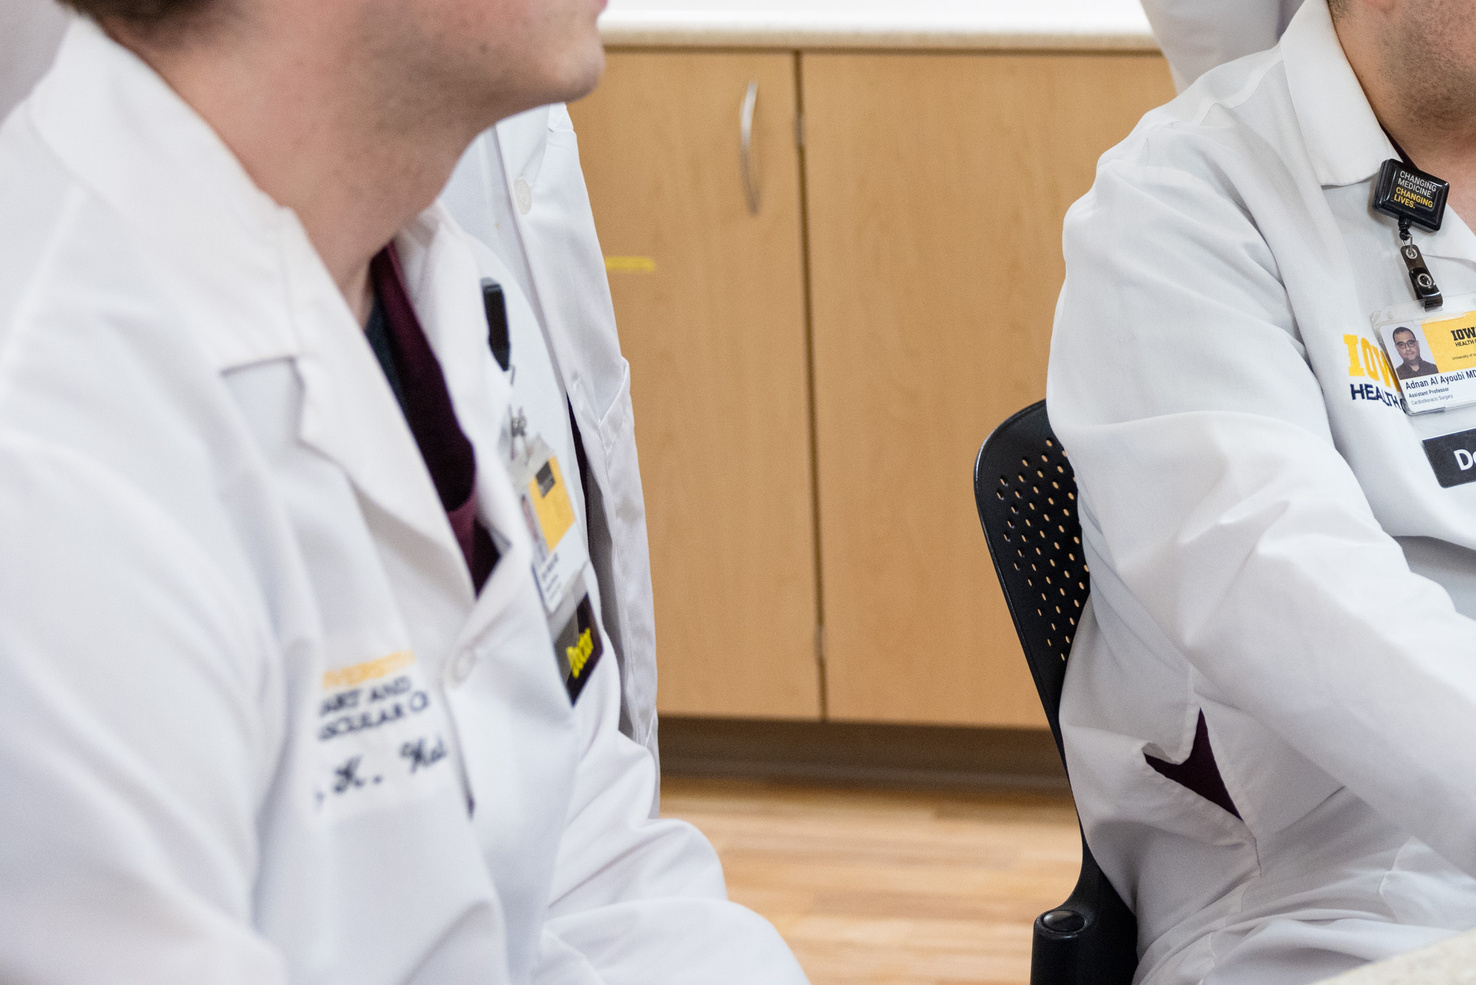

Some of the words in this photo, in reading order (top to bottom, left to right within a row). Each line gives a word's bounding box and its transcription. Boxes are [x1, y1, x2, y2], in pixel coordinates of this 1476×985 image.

[1397, 178, 1433, 198] MEDICINE.
[1399, 170, 1438, 192] CHANGING
[1393, 194, 1416, 209] LIVES.
[1395, 186, 1434, 208] CHANGING
[1454, 339, 1474, 347] HEALTH
[1343, 333, 1402, 392] IOW
[1405, 377, 1429, 390] Adnan
[1439, 372, 1466, 385] Ayoubi
[1350, 383, 1401, 411] HEALTH
[1408, 390, 1428, 398] Assistant
[1428, 387, 1449, 395] Professor
[1410, 397, 1439, 406] Cardiothoracic
